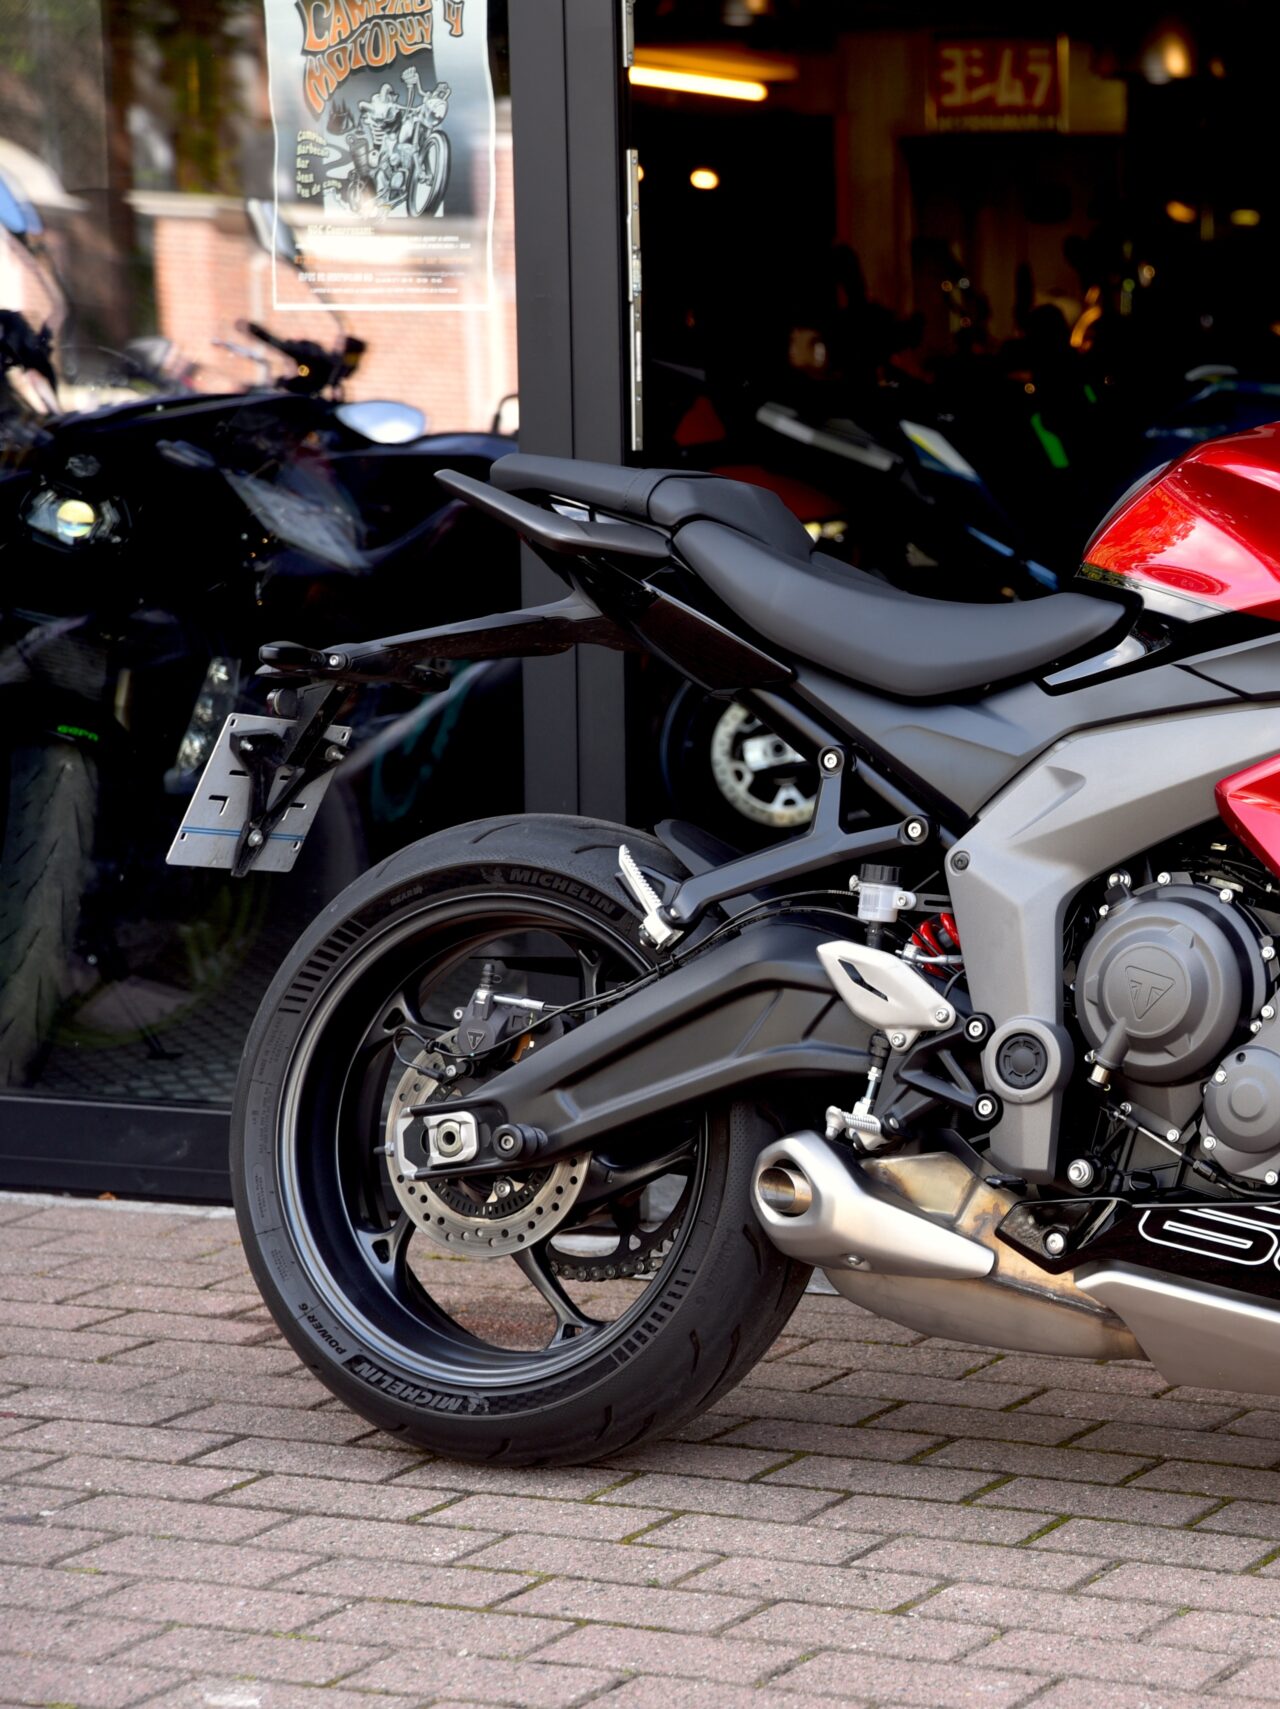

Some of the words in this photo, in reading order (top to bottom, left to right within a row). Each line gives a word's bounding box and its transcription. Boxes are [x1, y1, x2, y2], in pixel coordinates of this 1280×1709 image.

[305, 13, 432, 114] MOTORUN
[941, 48, 1052, 107] ヨシムラ
[296, 157, 311, 169] Bar
[509, 868, 617, 915] MICHELIN
[298, 1302, 309, 1312] 6
[307, 1314, 347, 1355] POWER
[354, 1361, 464, 1411] MICHELIN
